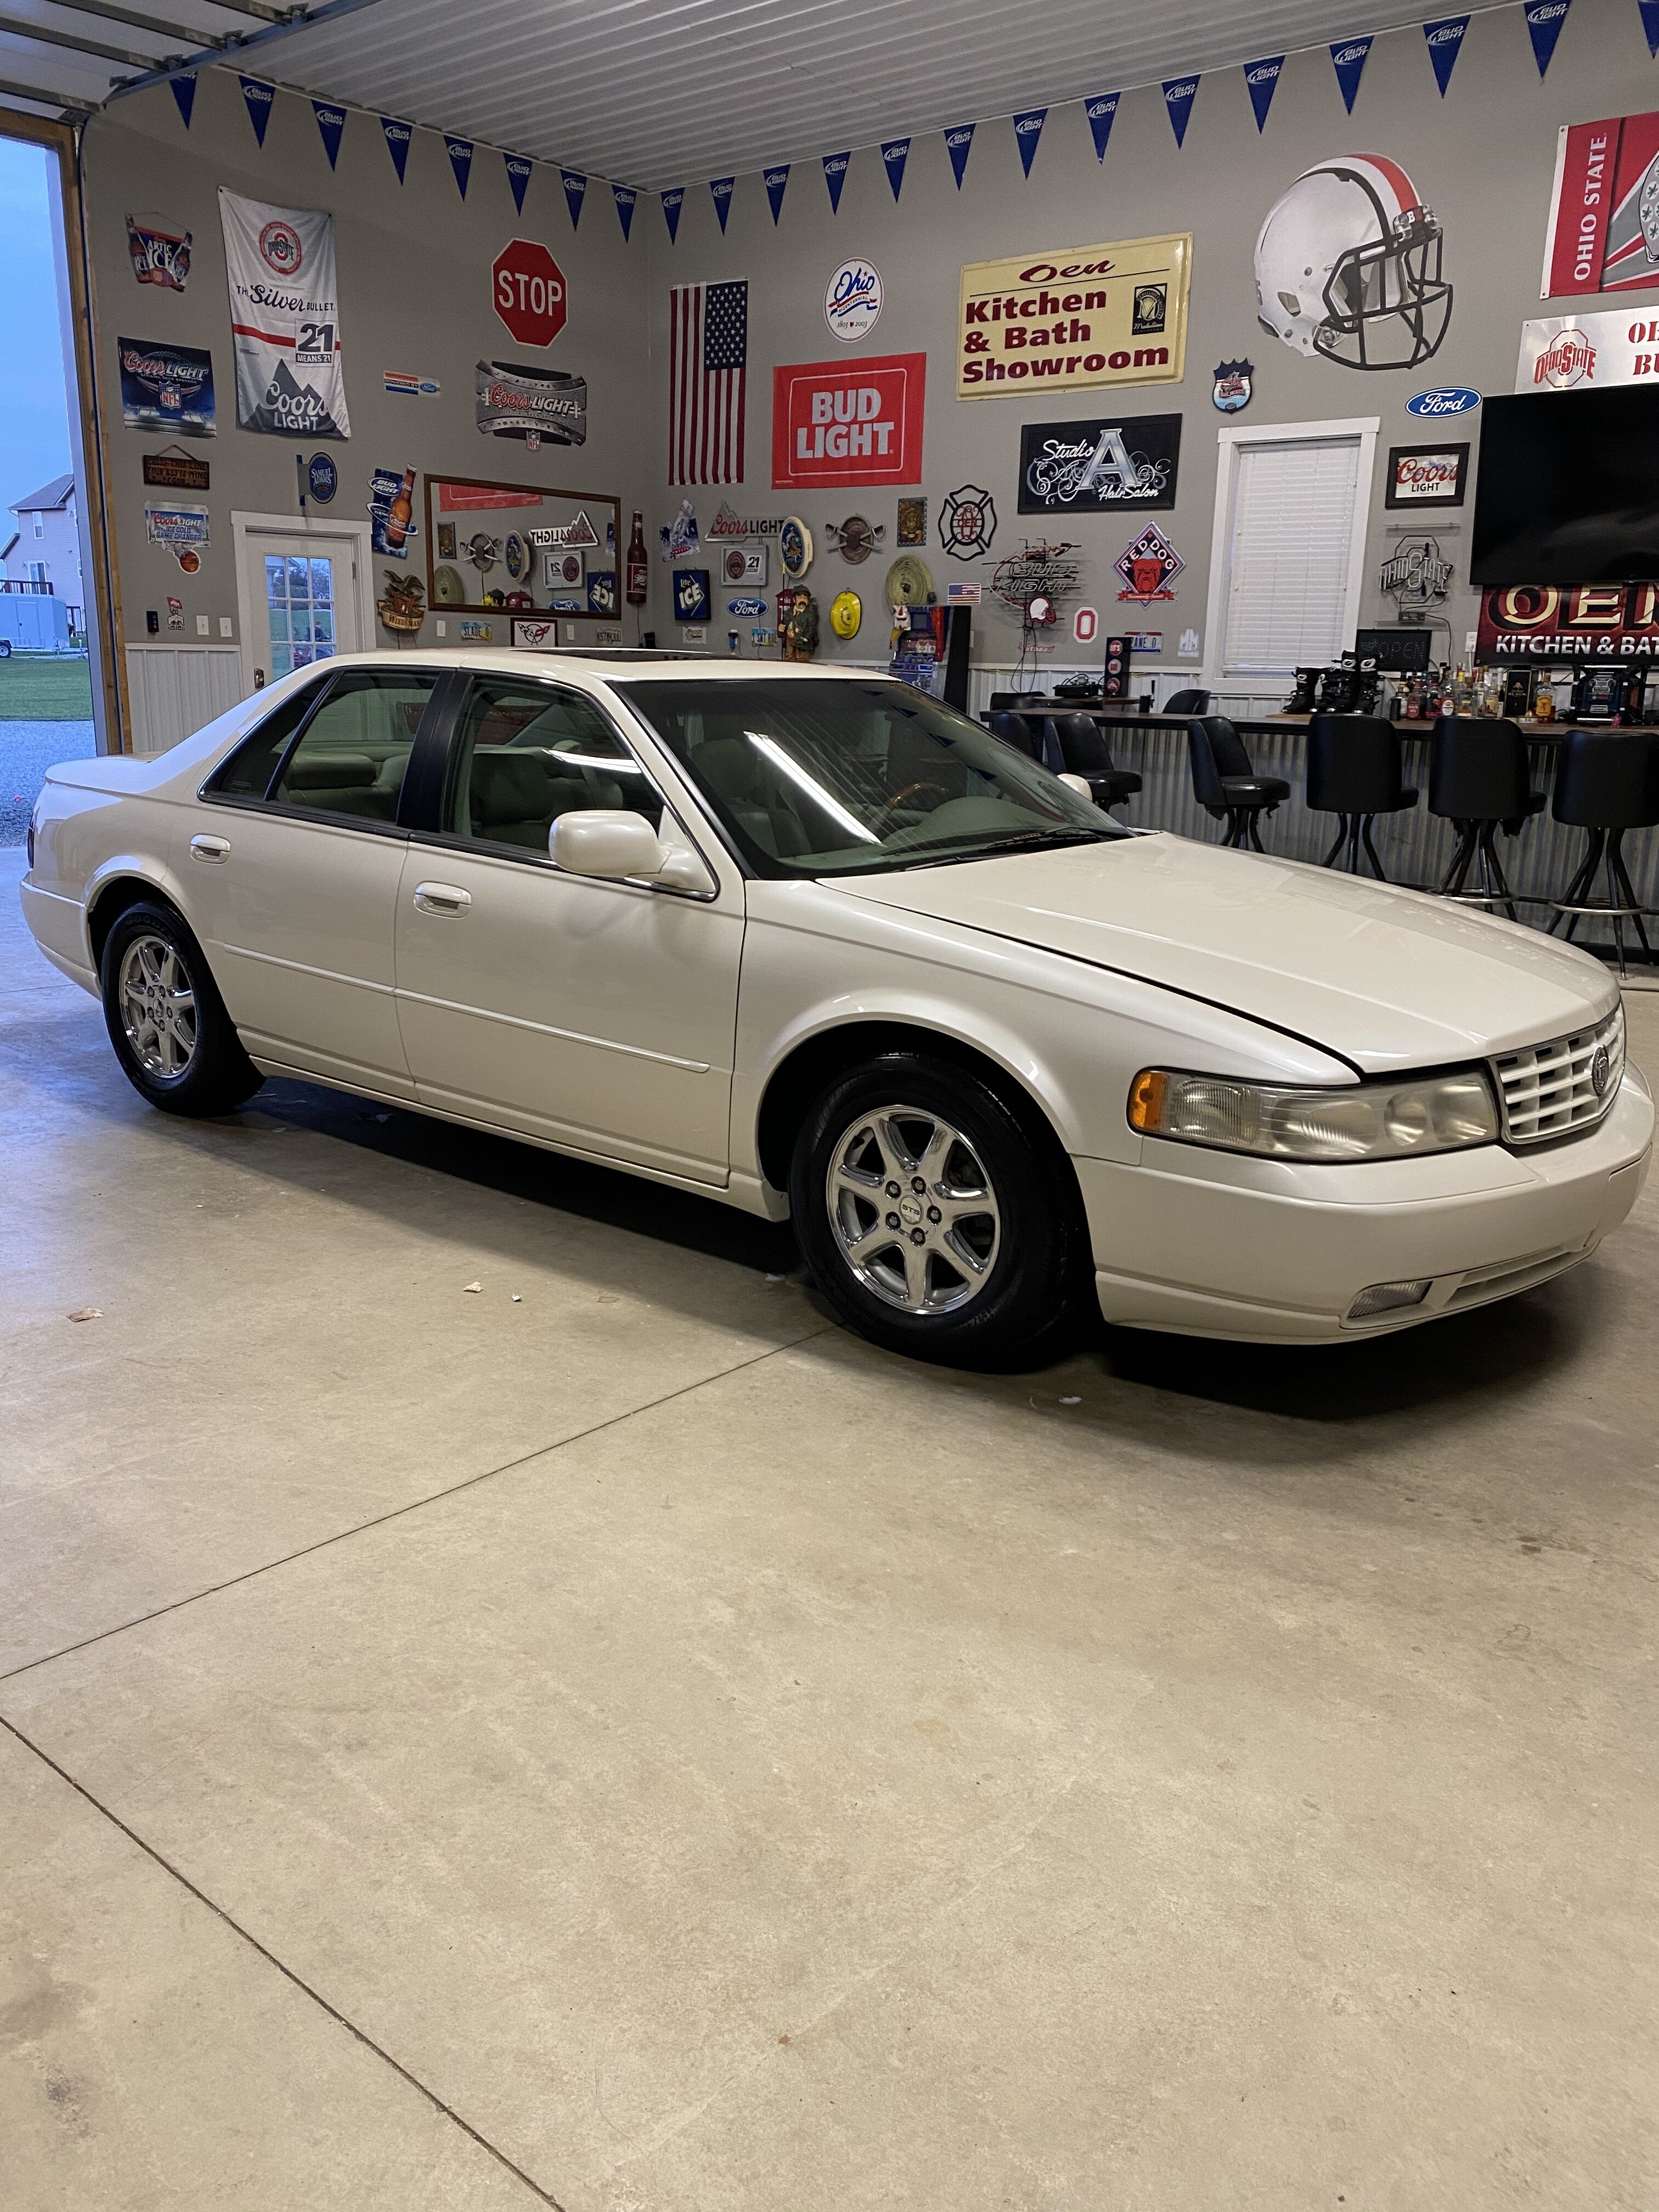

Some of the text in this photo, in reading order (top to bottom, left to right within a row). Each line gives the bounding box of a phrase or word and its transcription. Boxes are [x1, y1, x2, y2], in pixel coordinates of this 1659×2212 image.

[1534, 8, 1569, 20] LIGHT
[1541, 3, 1566, 14] BUD
[1433, 30, 1466, 43] LIGHT
[1438, 25, 1464, 36] BUD
[1340, 49, 1369, 63] LIGHT
[1345, 45, 1368, 55] BUD
[1252, 71, 1280, 81] LIGHT
[1257, 66, 1279, 76] BUD
[1170, 88, 1196, 99] LIGHT
[1175, 83, 1195, 92] BUD
[1092, 106, 1118, 115] LIGHT
[1097, 100, 1116, 110] BUD
[1574, 136, 1607, 281] OHIO STATE
[1019, 260, 1116, 283] Oen
[834, 267, 875, 302] Ohio
[251, 285, 306, 312] Silver
[499, 270, 562, 316] STOP
[839, 296, 868, 313] BICENTENNIAL
[966, 290, 1107, 324] Kitchen
[837, 320, 848, 330] 1803
[298, 323, 334, 352] 21
[964, 318, 1091, 354] & Bath
[297, 354, 322, 363] MEANS
[963, 347, 1169, 383] Showroom
[1533, 345, 1596, 385] OHIO STATE
[124, 351, 166, 375] Coors
[166, 362, 208, 381] LIGHT
[162, 392, 179, 406] NFL
[259, 380, 328, 416] Coors
[490, 383, 572, 415] Coors LIGHT
[1420, 392, 1466, 414] Ford
[811, 387, 882, 424] BUD
[274, 411, 318, 431] LIGHT
[528, 439, 539, 449] NFL
[797, 421, 894, 459] LIGHT
[1043, 428, 1142, 489] Studio A
[311, 467, 333, 477] SAMUEL
[1397, 459, 1458, 484] Coors
[313, 475, 331, 486] ADAMS
[376, 479, 397, 488] BUD
[1412, 483, 1440, 492] LIGHT
[373, 484, 399, 494] LIGHT
[153, 513, 204, 527] Coors LIGHT
[710, 515, 785, 534] Coors LIGHT
[174, 533, 201, 541] CHANGER
[747, 556, 760, 568] 21
[1120, 539, 1175, 572] RED DOG
[1013, 563, 1071, 577] BUD
[996, 578, 1076, 592] LIGHT
[679, 583, 702, 609] ICE
[735, 600, 760, 614] Ford
[1496, 635, 1592, 654] KITCHEN
[1596, 636, 1615, 655] &
[902, 1204, 920, 1215] STS
